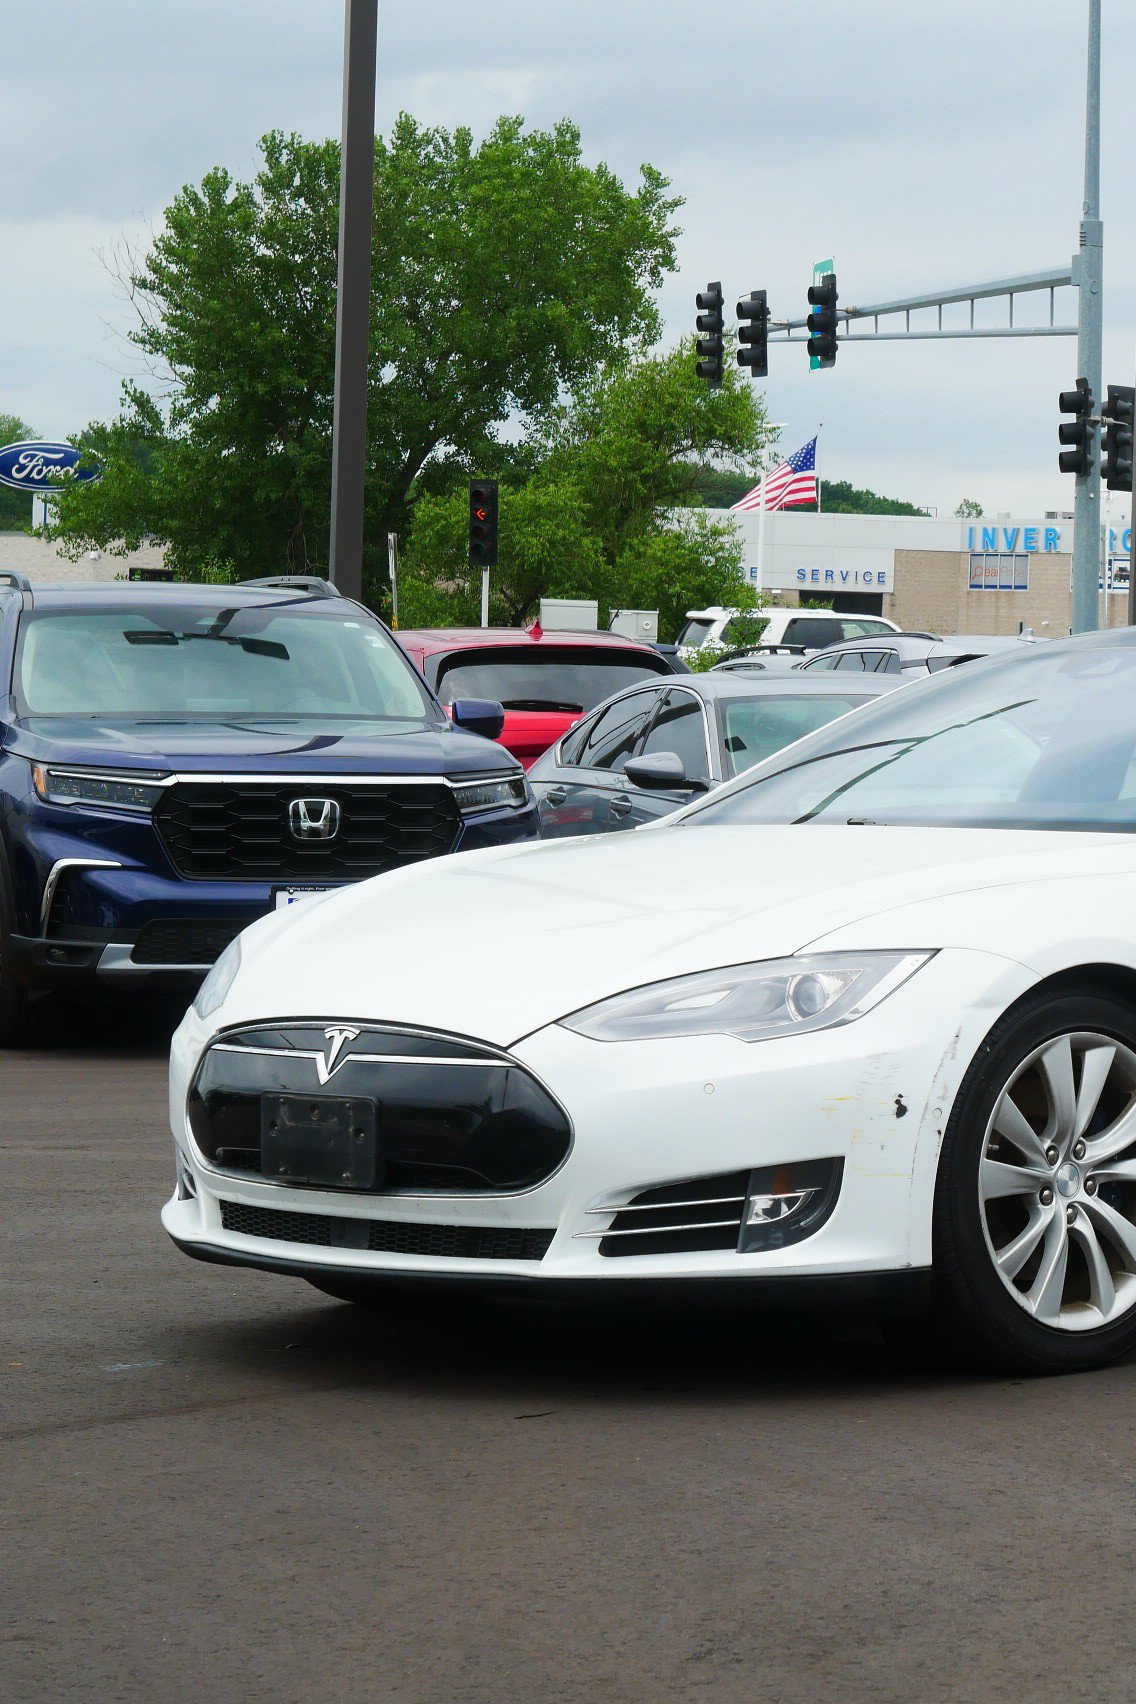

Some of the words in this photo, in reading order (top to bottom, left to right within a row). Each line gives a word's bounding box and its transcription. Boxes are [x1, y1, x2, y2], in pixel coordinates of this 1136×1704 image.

[12, 451, 80, 480] Ford
[968, 526, 1060, 552] INVER
[797, 568, 886, 583] SERVICE
